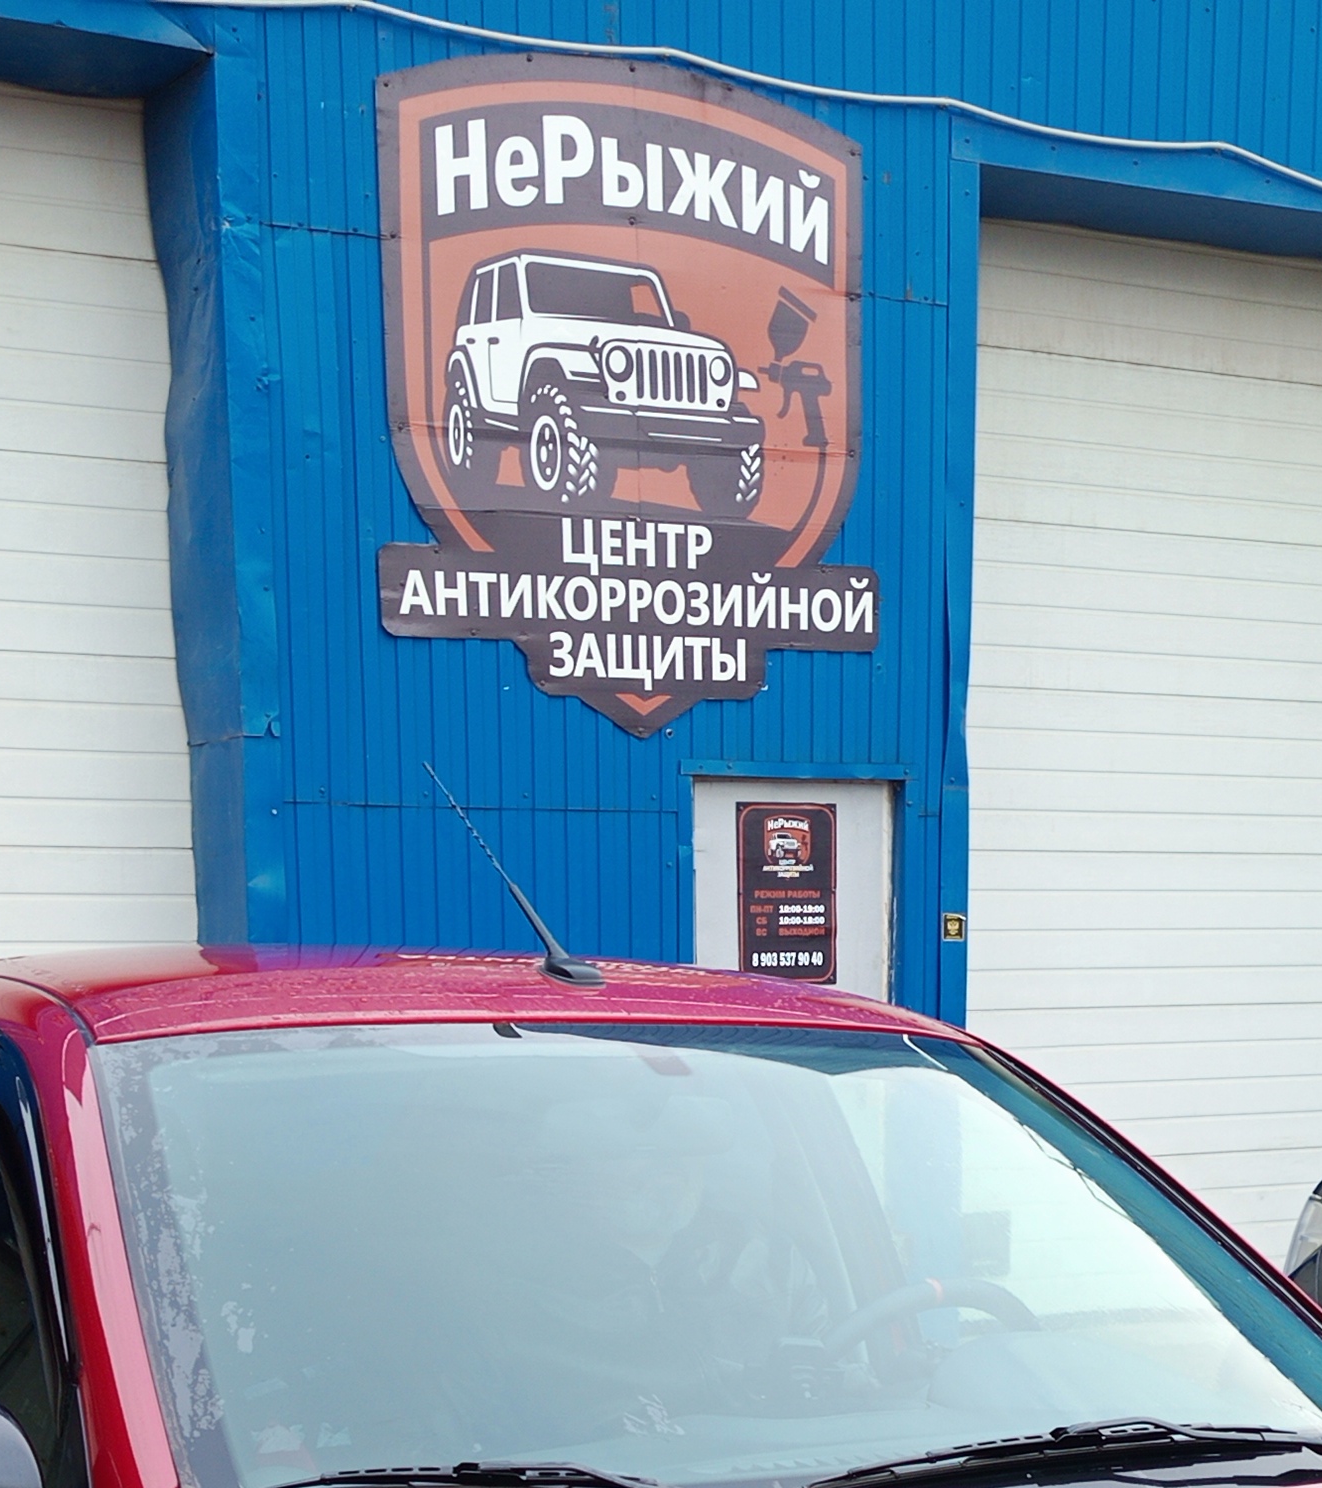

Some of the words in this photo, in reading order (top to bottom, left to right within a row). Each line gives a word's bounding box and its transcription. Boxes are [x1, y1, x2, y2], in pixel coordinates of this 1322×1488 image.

[434, 115, 829, 265] НеРыжий
[561, 516, 713, 574] ЦЕНТР
[399, 569, 873, 634] АНТИКОРРОЗИЙНОЙ
[548, 631, 747, 690] ЗАЩИТЫ
[754, 890, 785, 898] РЕЖИМ
[787, 890, 820, 898] РАБОТЫ
[752, 952, 759, 967] 8
[760, 952, 778, 967] 903
[779, 952, 796, 967] 537
[798, 951, 810, 966] 90
[811, 951, 824, 966] 40
